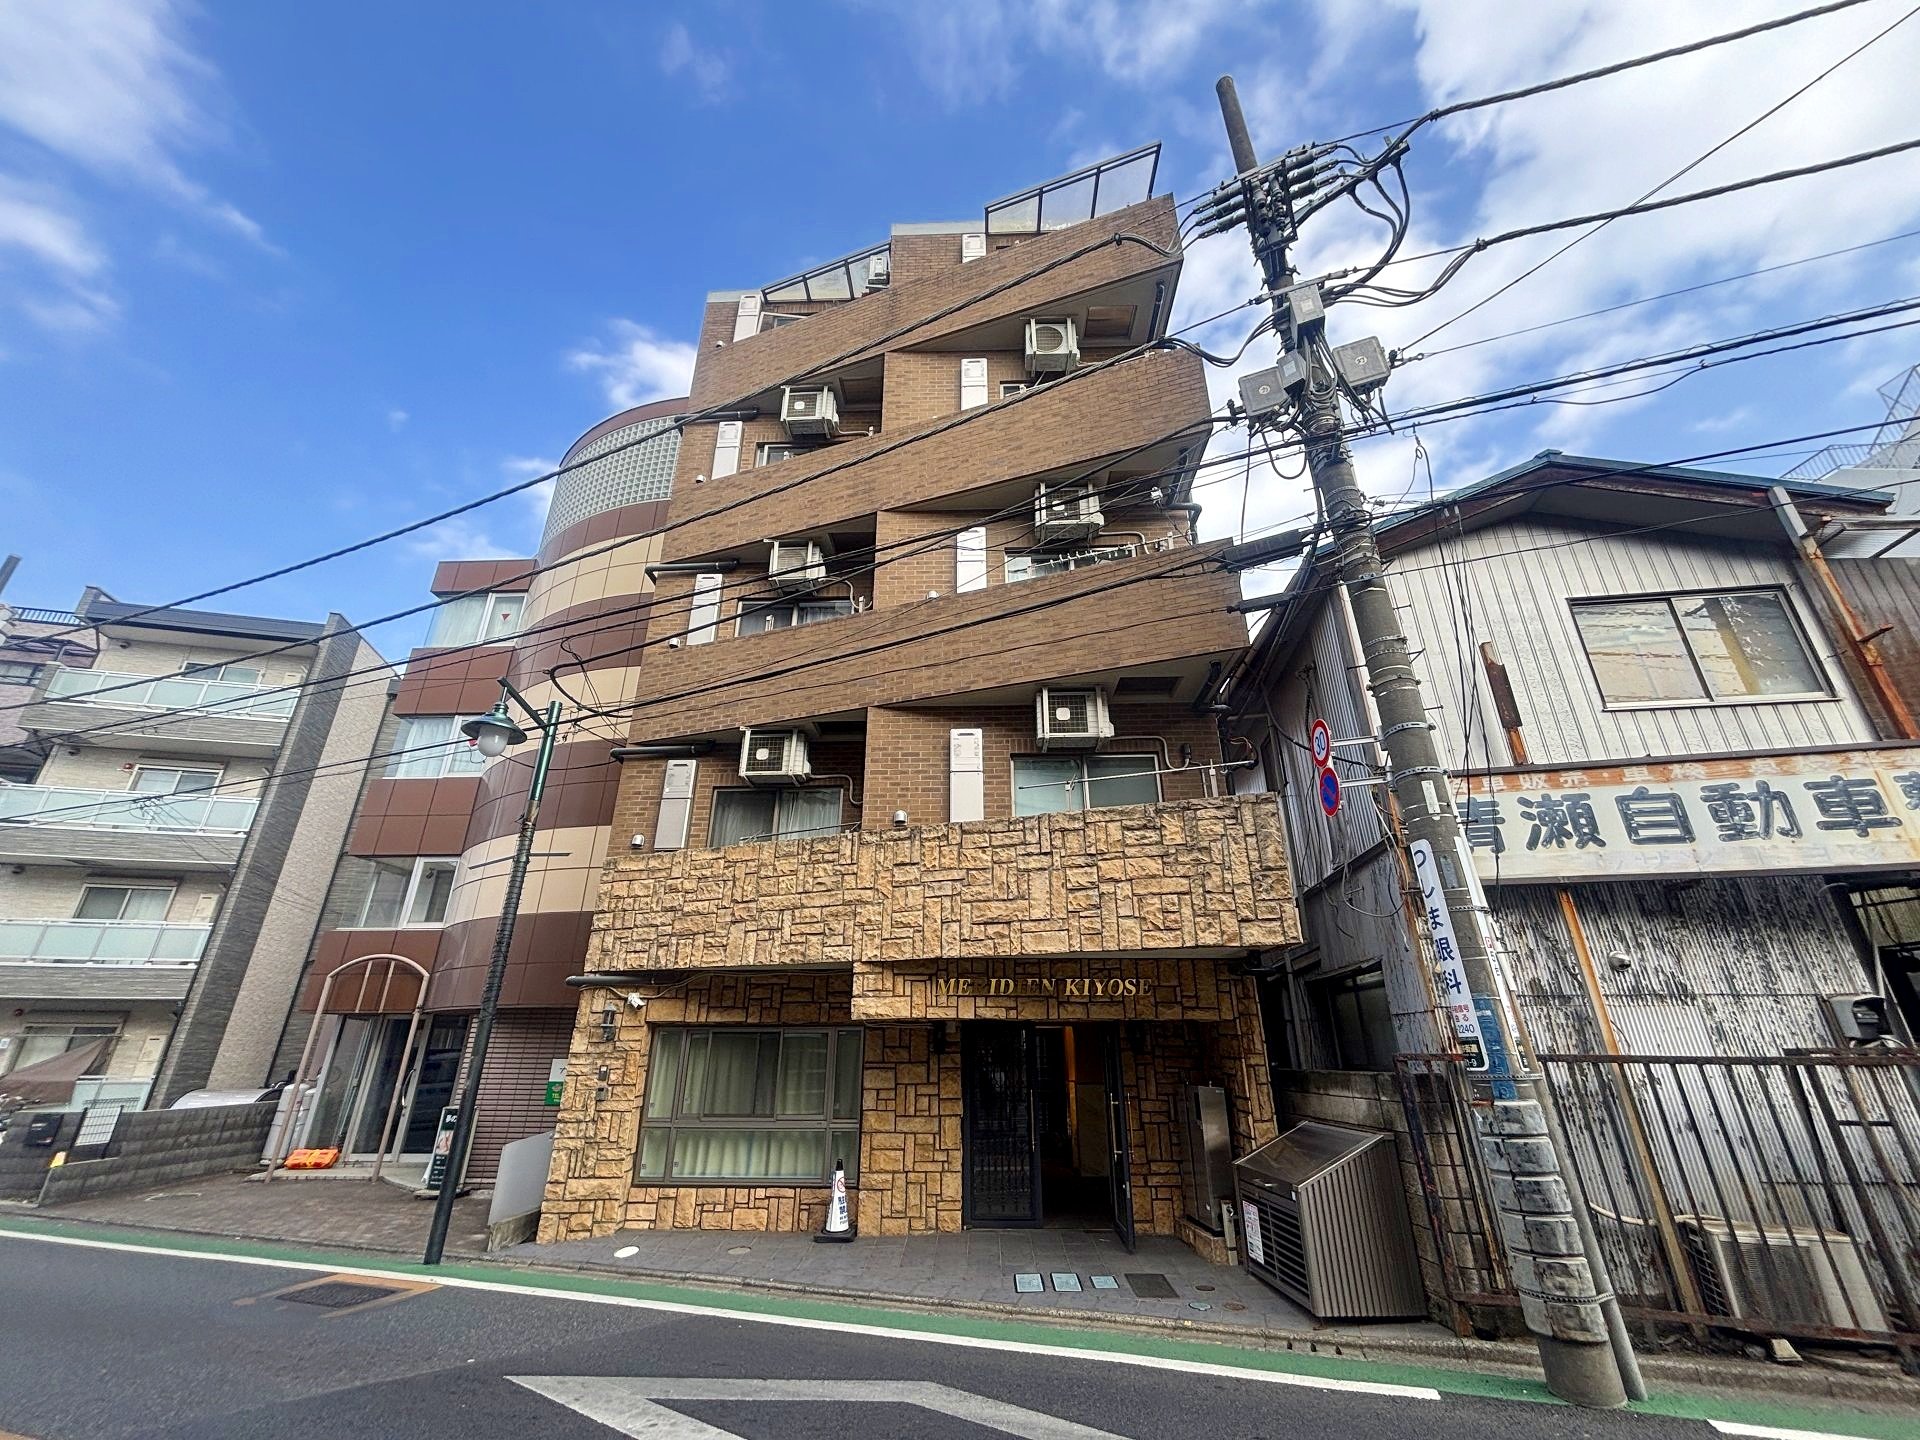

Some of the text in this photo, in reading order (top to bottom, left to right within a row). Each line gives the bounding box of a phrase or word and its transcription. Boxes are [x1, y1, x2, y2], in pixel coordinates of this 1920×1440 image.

[1315, 730, 1327, 756] 30
[935, 977, 1153, 997] MEIDIEN KIYOSE
